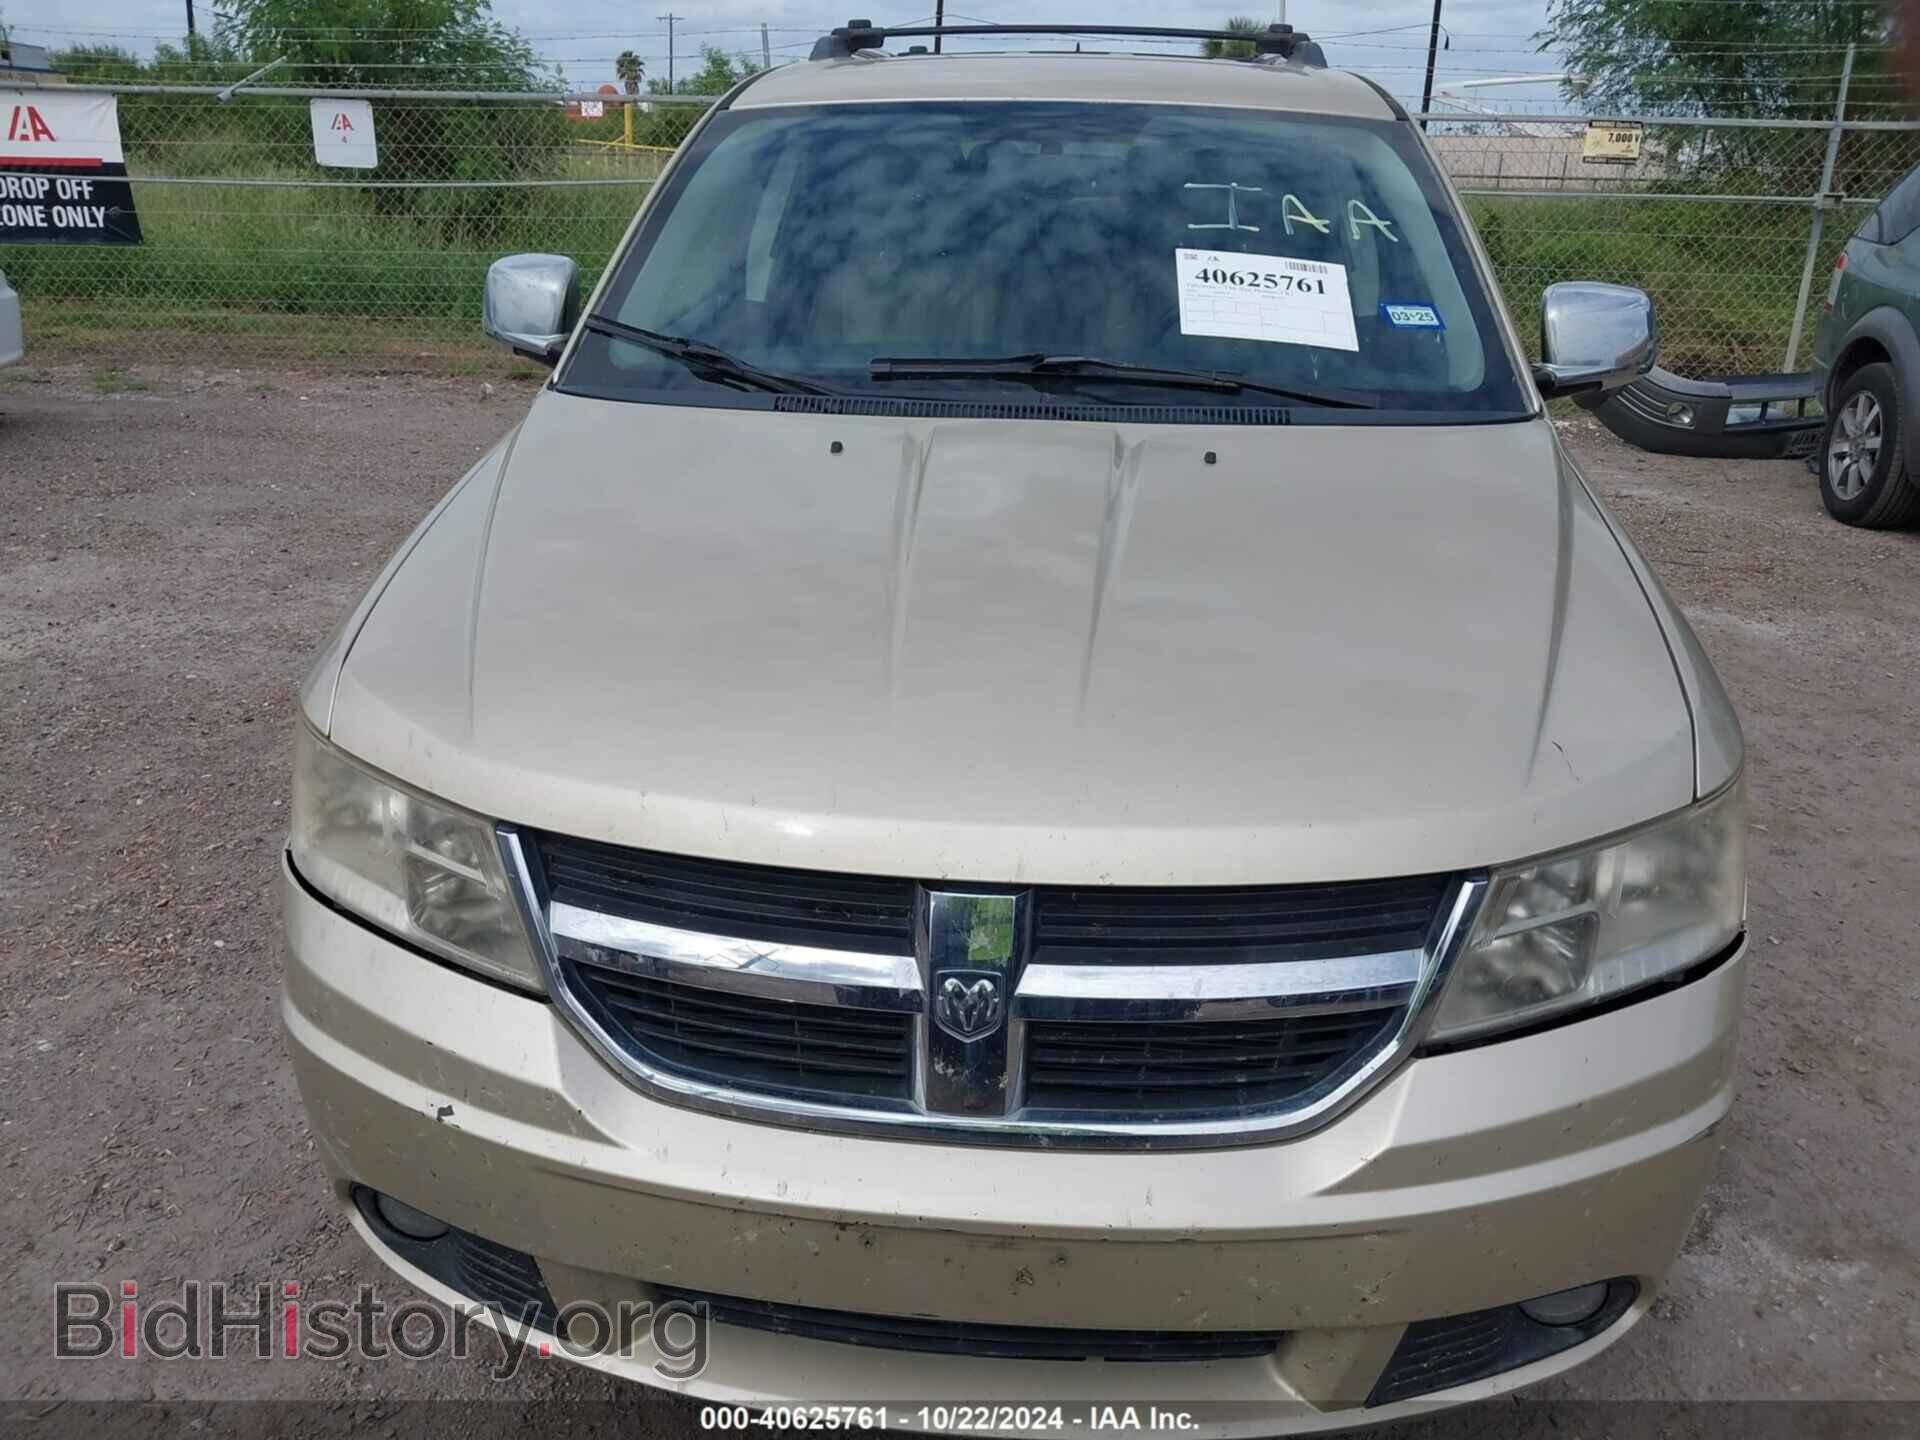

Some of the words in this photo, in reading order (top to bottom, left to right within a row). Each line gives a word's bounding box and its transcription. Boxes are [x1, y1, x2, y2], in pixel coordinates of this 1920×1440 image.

[1608, 132, 1633, 145] 7,000
[55, 178, 94, 200] OFF
[0, 204, 48, 227] ONE
[52, 206, 106, 228] ONLY
[1195, 267, 1326, 295] 40625761
